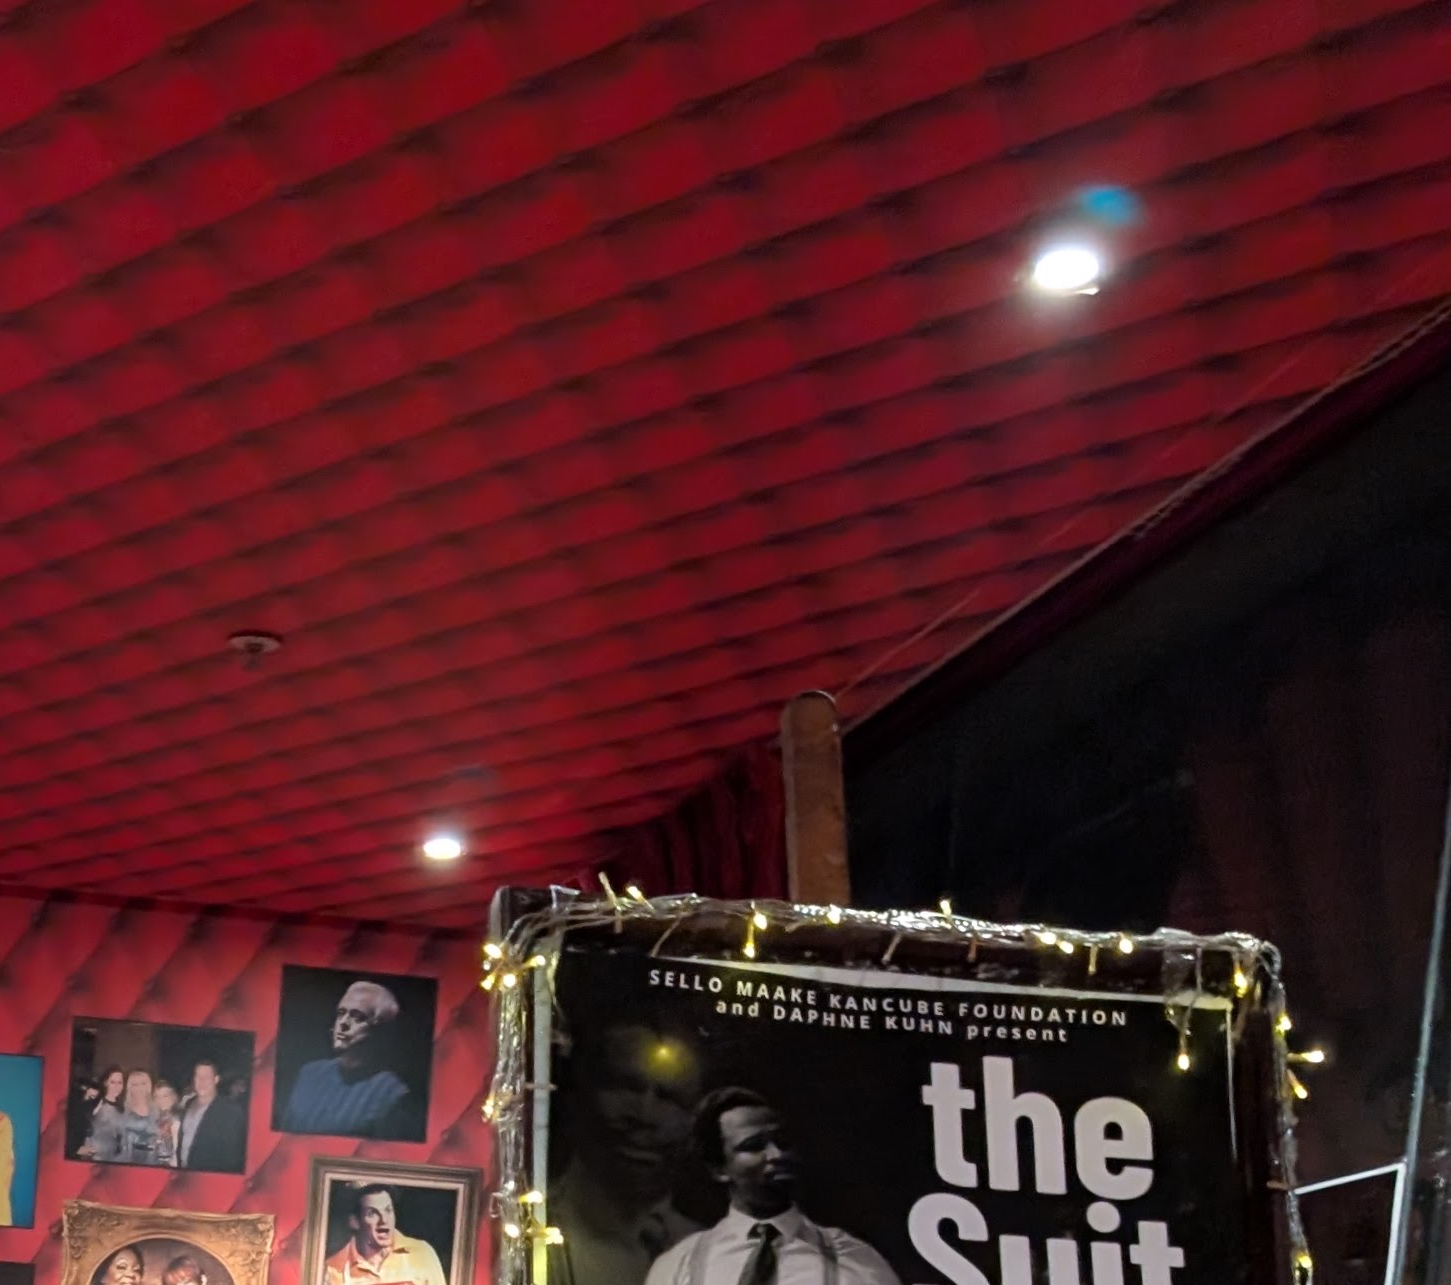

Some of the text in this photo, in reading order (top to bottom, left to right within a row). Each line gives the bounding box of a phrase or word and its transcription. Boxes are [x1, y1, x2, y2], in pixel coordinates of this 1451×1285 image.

[649, 969, 1127, 1026] SELLO MAAKE KANCUBE FOUNDATION
[716, 1000, 1068, 1043] and DAPHNE KUHN present
[921, 1055, 1154, 1200] the
